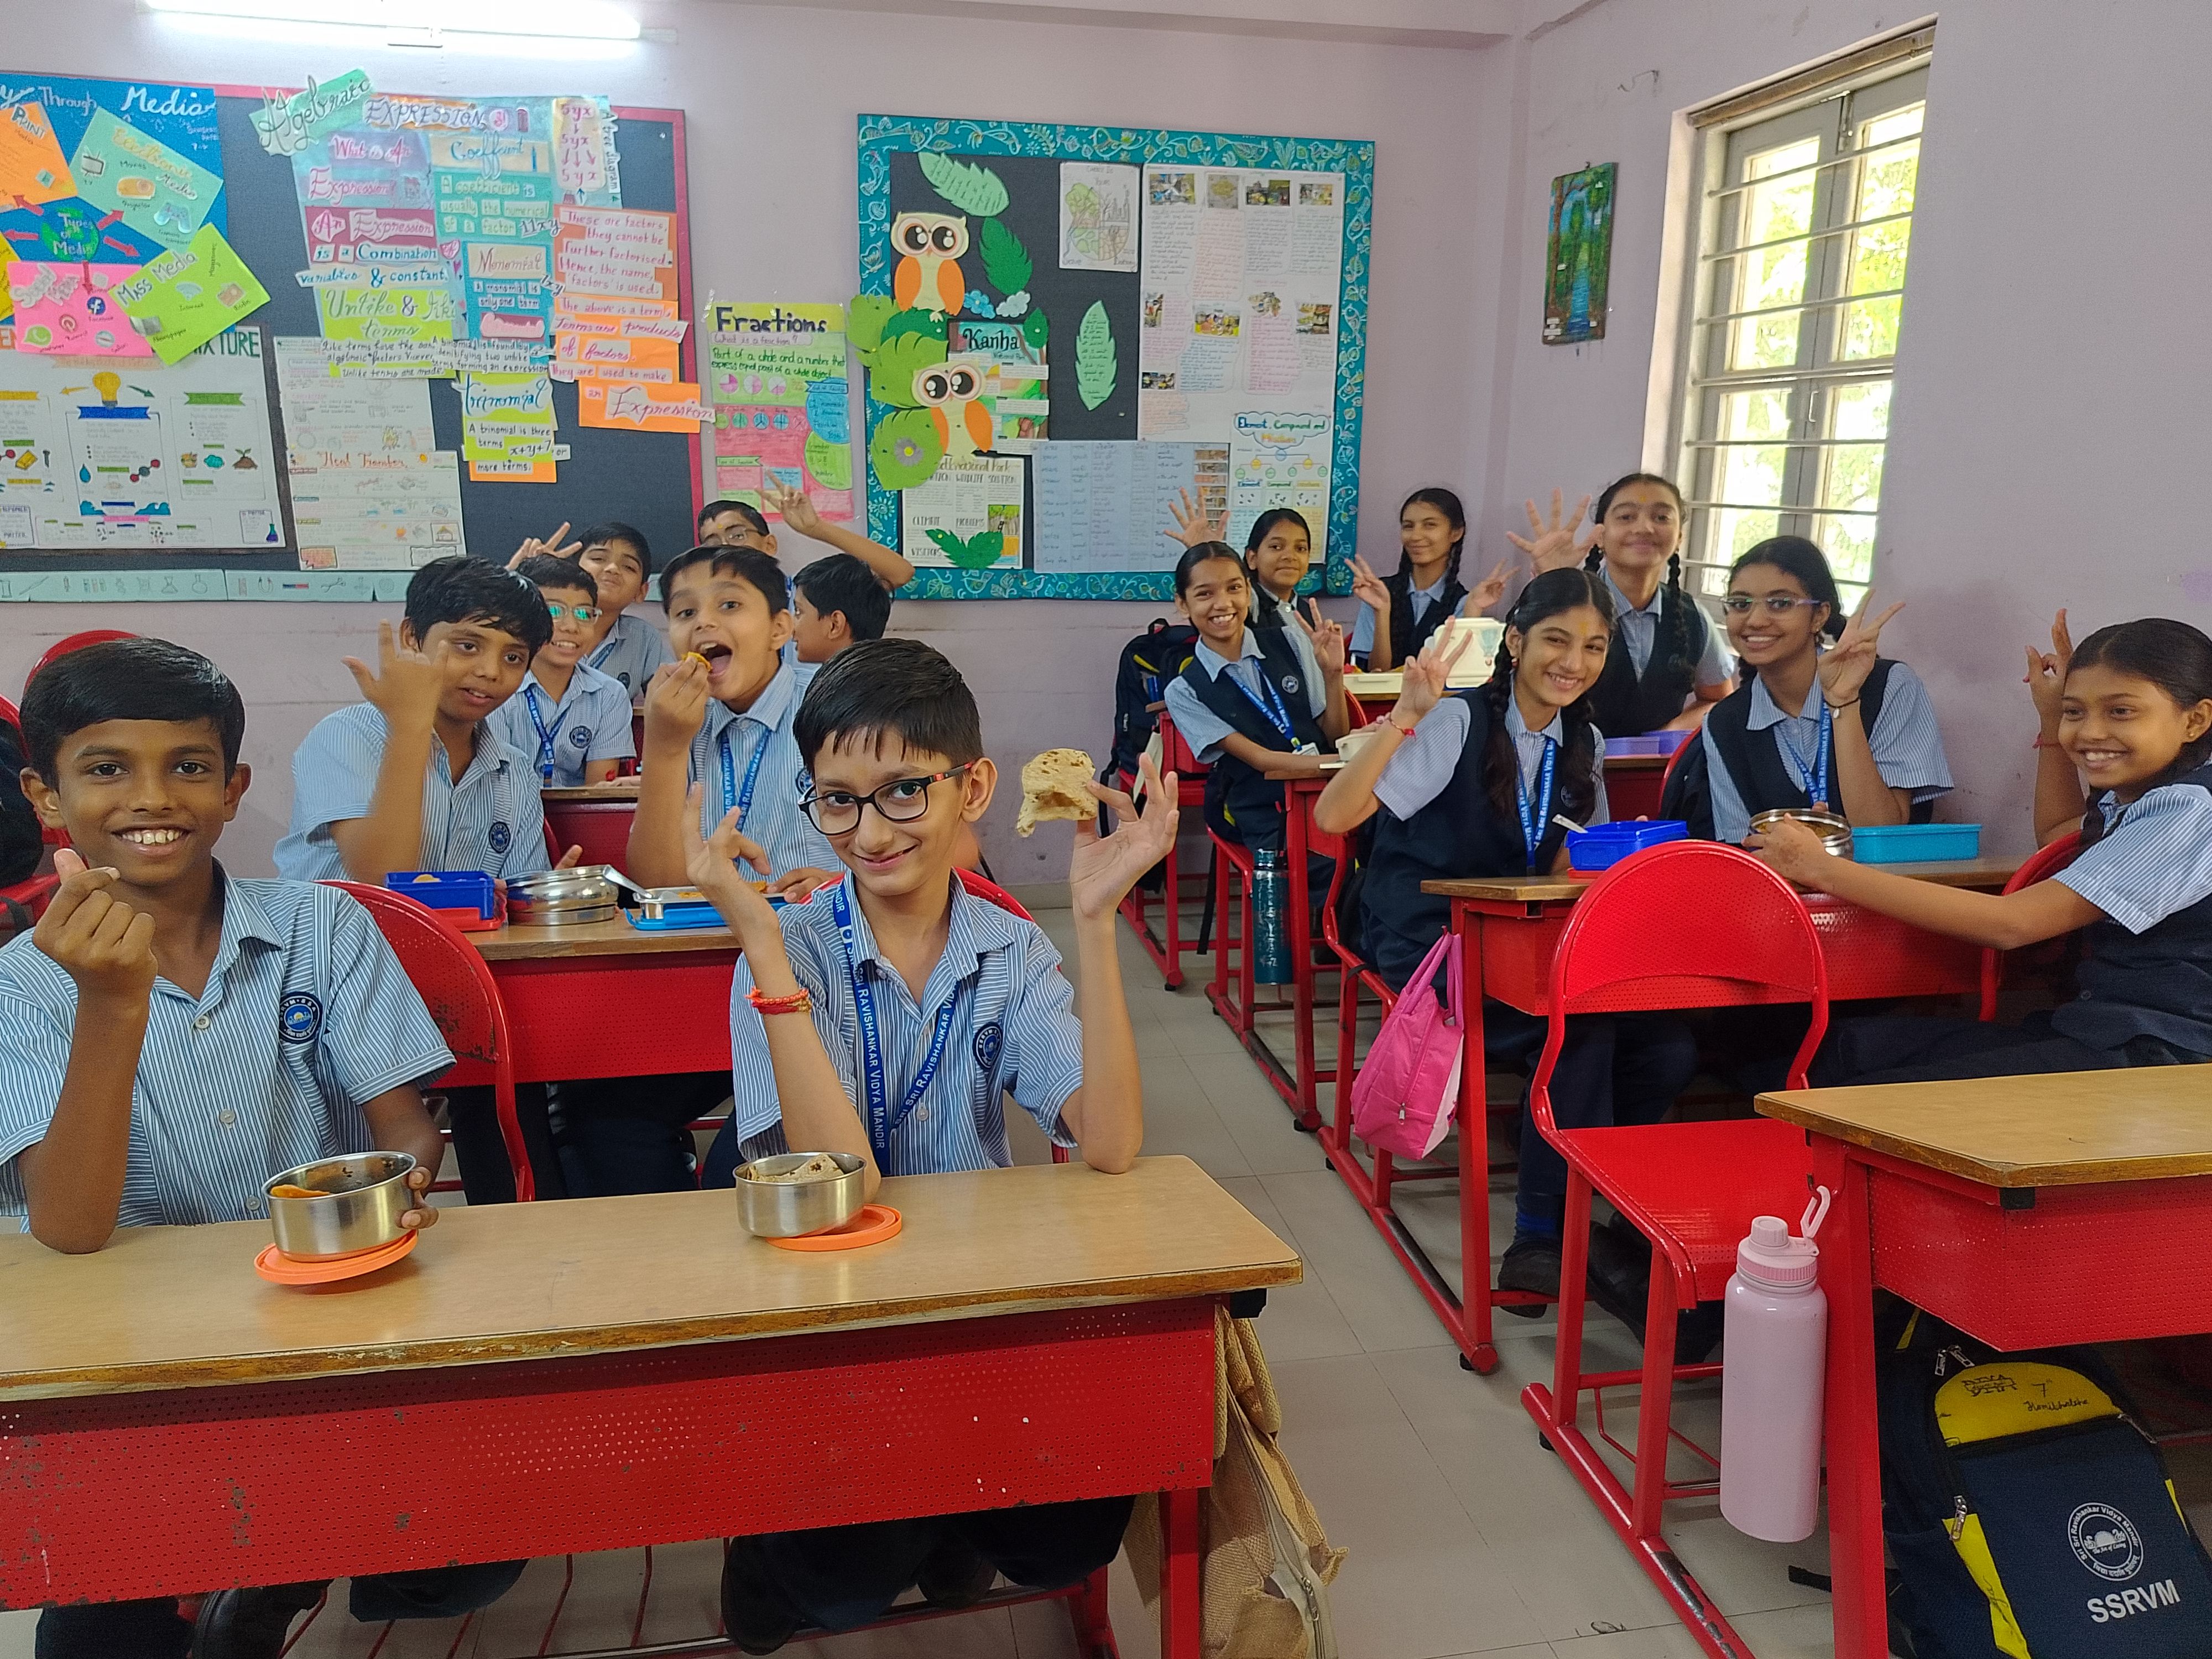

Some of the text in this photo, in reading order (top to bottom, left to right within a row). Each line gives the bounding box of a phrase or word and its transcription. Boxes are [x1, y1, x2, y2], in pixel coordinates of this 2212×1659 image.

[38, 85, 216, 117] Through Media
[333, 135, 364, 157] What
[442, 197, 477, 216] usually
[483, 202, 499, 214] the
[564, 211, 601, 223] These
[604, 218, 622, 227] are
[587, 227, 664, 245] they cannot be
[317, 247, 330, 259] is
[358, 243, 437, 260] Combination
[565, 241, 605, 257] further
[371, 268, 386, 288] &
[600, 263, 618, 275] the
[617, 281, 624, 291] is
[325, 290, 395, 318] Unlike
[561, 298, 578, 311] The
[585, 302, 614, 312] above
[716, 305, 828, 333] Fractions
[346, 339, 371, 352] terms
[374, 338, 394, 351] have
[399, 338, 413, 351] the
[491, 337, 516, 349] found
[519, 338, 529, 353] by
[562, 336, 576, 357] of
[962, 328, 1020, 352] Kanha
[504, 352, 528, 362] unlike
[342, 368, 367, 378] Unlike
[503, 363, 549, 373] expression
[552, 364, 574, 382] They
[602, 367, 625, 378] used
[630, 369, 639, 378] to
[643, 370, 667, 381] make
[608, 385, 714, 424] Expression
[469, 423, 476, 433] A
[480, 422, 516, 435] trinomial
[531, 424, 551, 435] three
[1274, 419, 1311, 432] Compound
[478, 439, 567, 456] terms or
[722, 743, 732, 791] RAVISHANKAR
[742, 753, 762, 803] RAVISHANKAR
[740, 804, 749, 817] SRI
[905, 1089, 921, 1106] SRI
[915, 1012, 950, 1088] RAVISHANKAR
[857, 989, 885, 1149] RAVISHANKAR VIDYA MANDIR
[2070, 1506, 2138, 1560] Sri Sri Ravishankar Vidya Mandir
[2087, 1579, 2181, 1623] SSRVM
